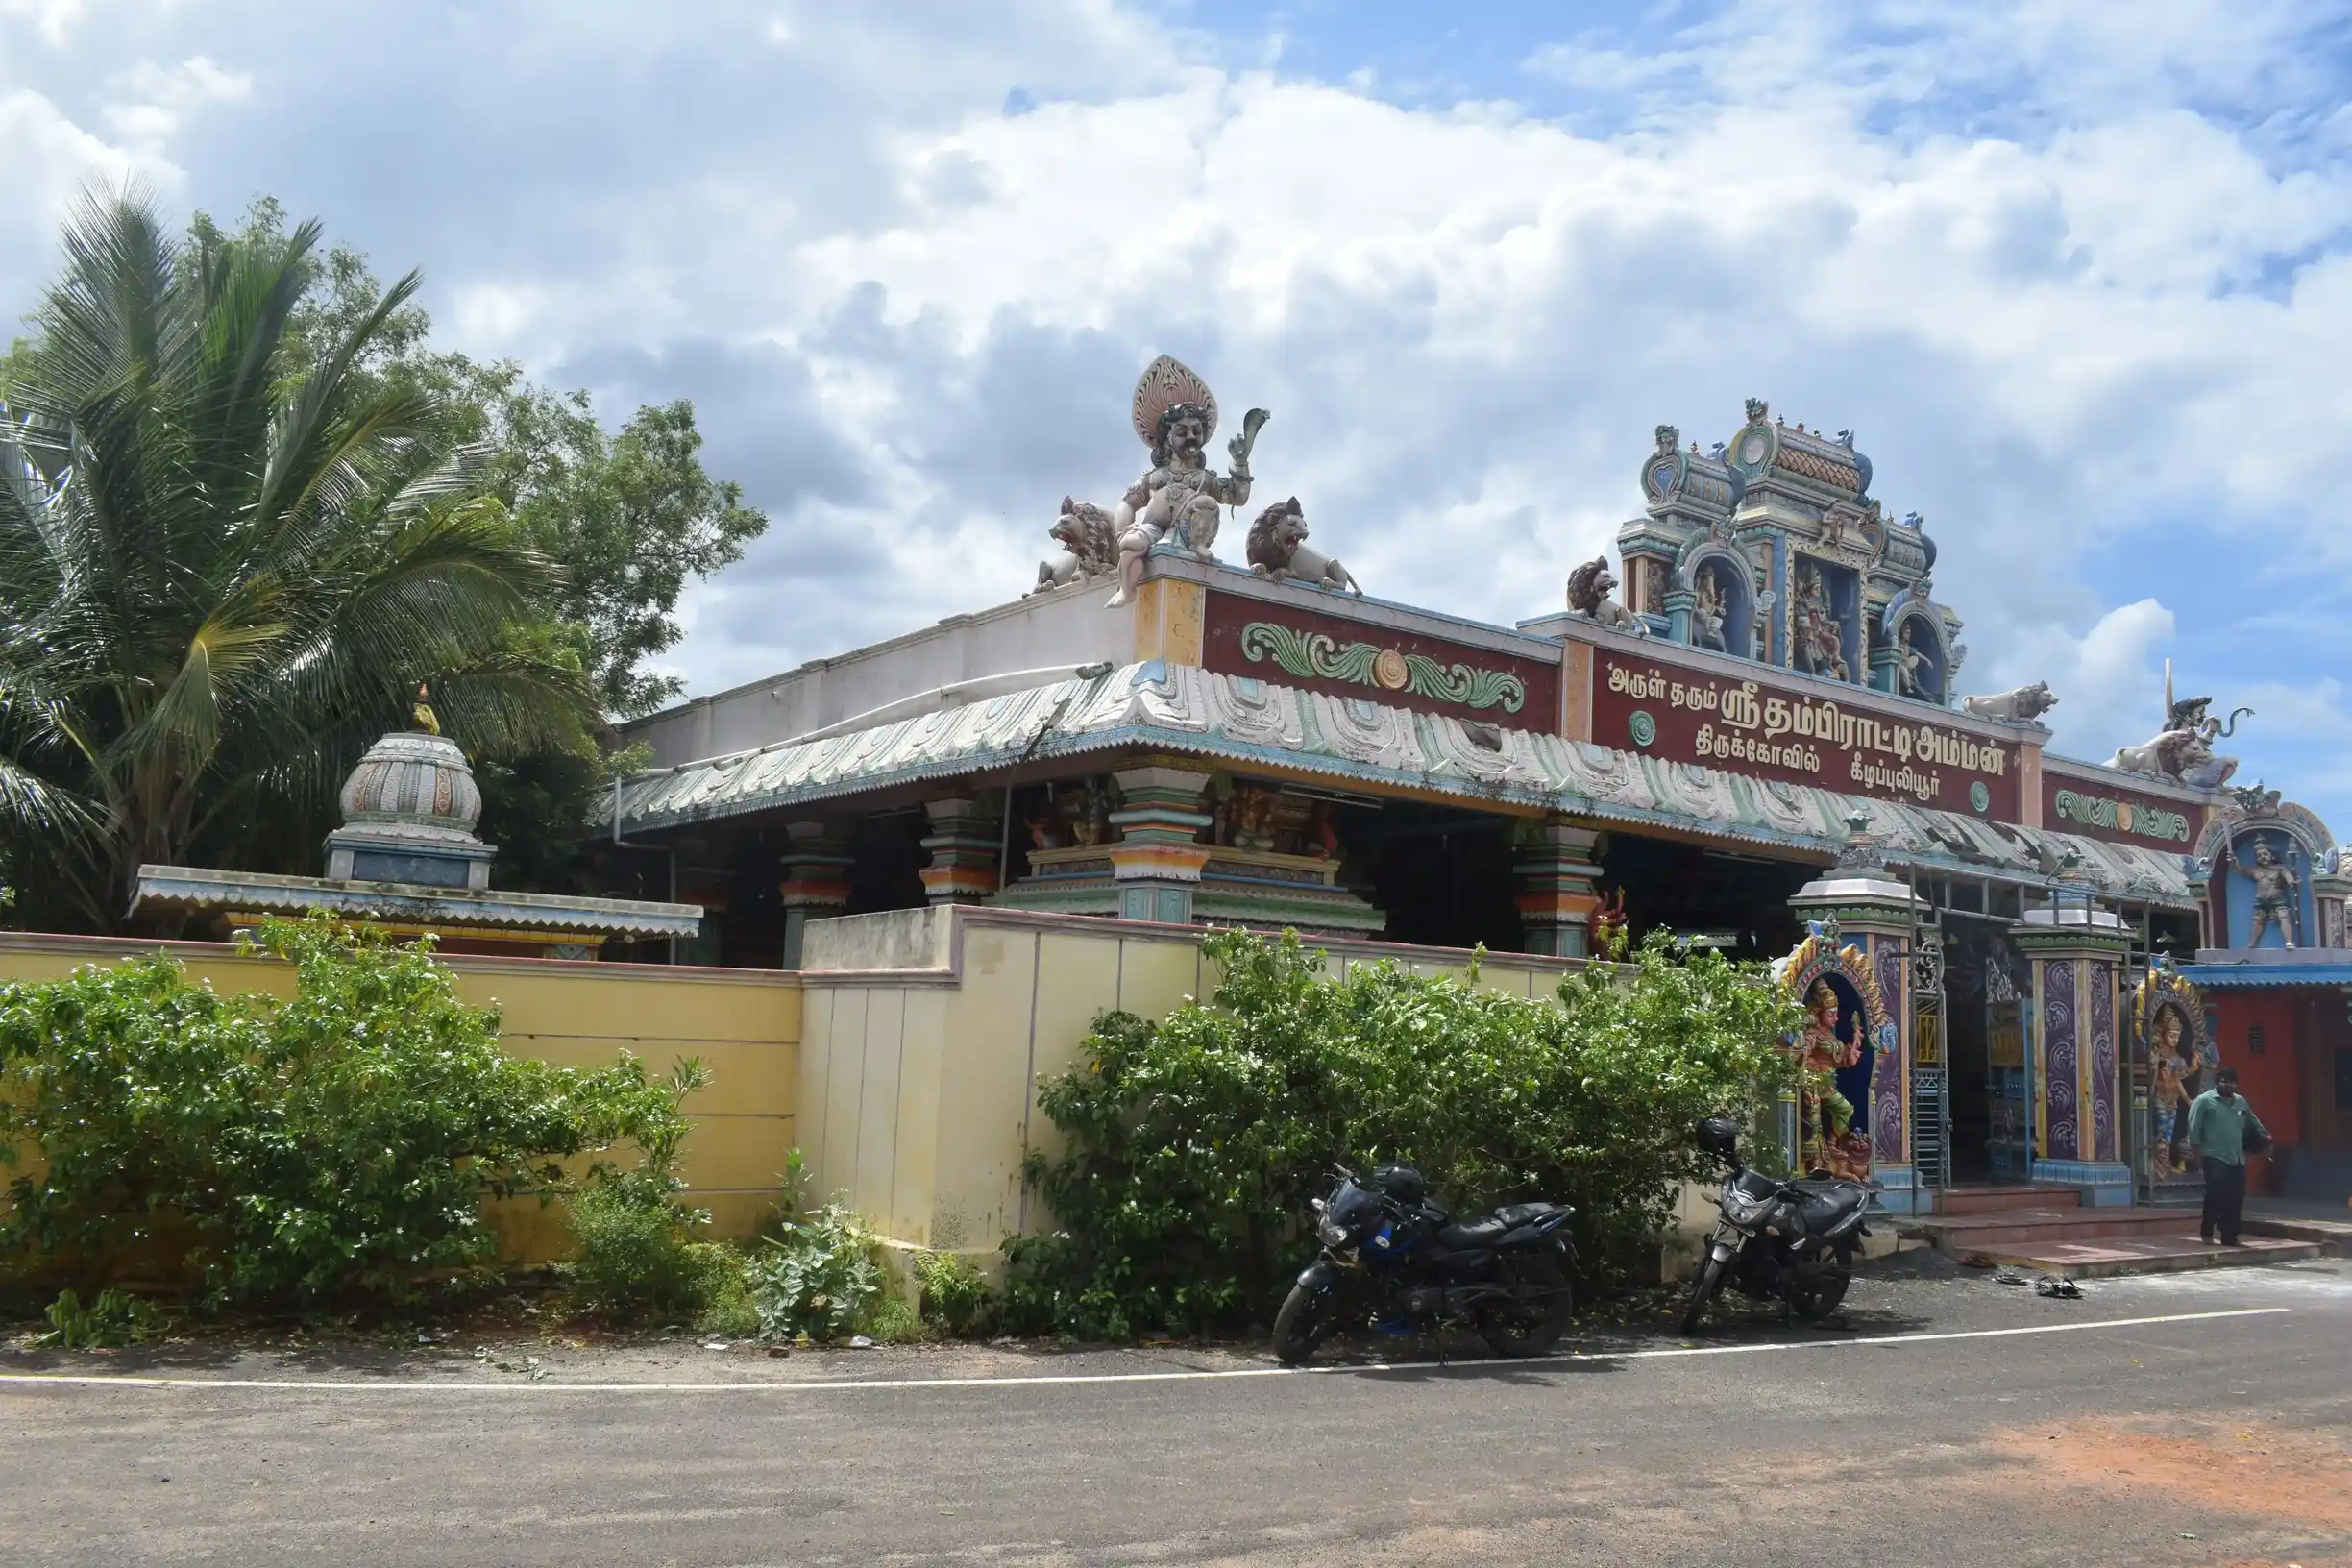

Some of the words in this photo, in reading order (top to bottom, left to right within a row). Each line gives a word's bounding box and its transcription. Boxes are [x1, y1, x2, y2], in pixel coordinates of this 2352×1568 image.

[1608, 667, 1666, 699] அருள்
[1670, 681, 1718, 711] தரும்
[1764, 695, 1912, 763] தம்பிராட்டி
[1915, 725, 2006, 776] அம்மன்
[1695, 723, 1820, 773] திருக்கோவில்
[1850, 750, 1941, 801] கீழப்புலியூர்
